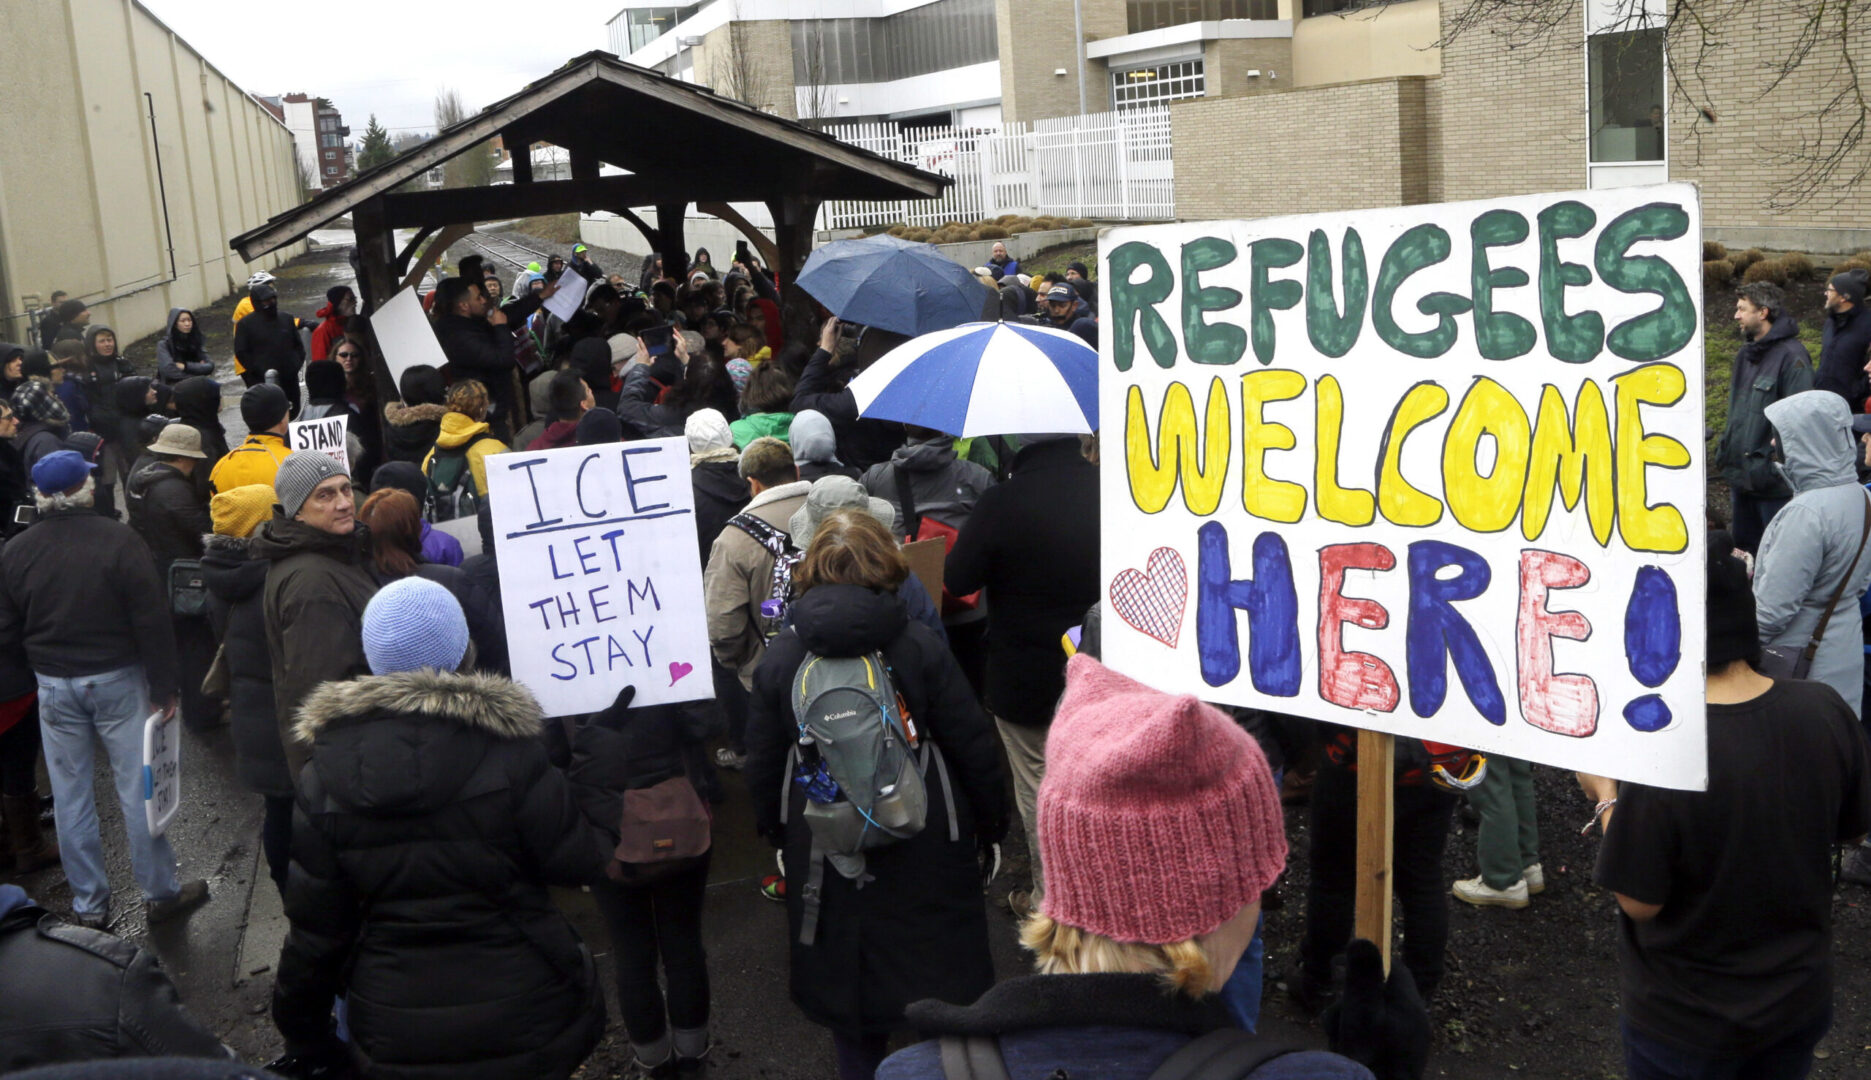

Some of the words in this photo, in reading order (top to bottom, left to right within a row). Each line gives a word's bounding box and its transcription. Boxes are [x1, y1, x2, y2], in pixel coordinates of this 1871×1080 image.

[1107, 200, 1697, 372] REFUGEES
[297, 420, 343, 450] STAND
[1124, 361, 1691, 554] WELCOME
[548, 529, 625, 580] LET
[529, 576, 661, 630] THEM
[1197, 521, 1682, 738] HERE!
[551, 625, 654, 681] STAY
[830, 710, 857, 720] Columbia
